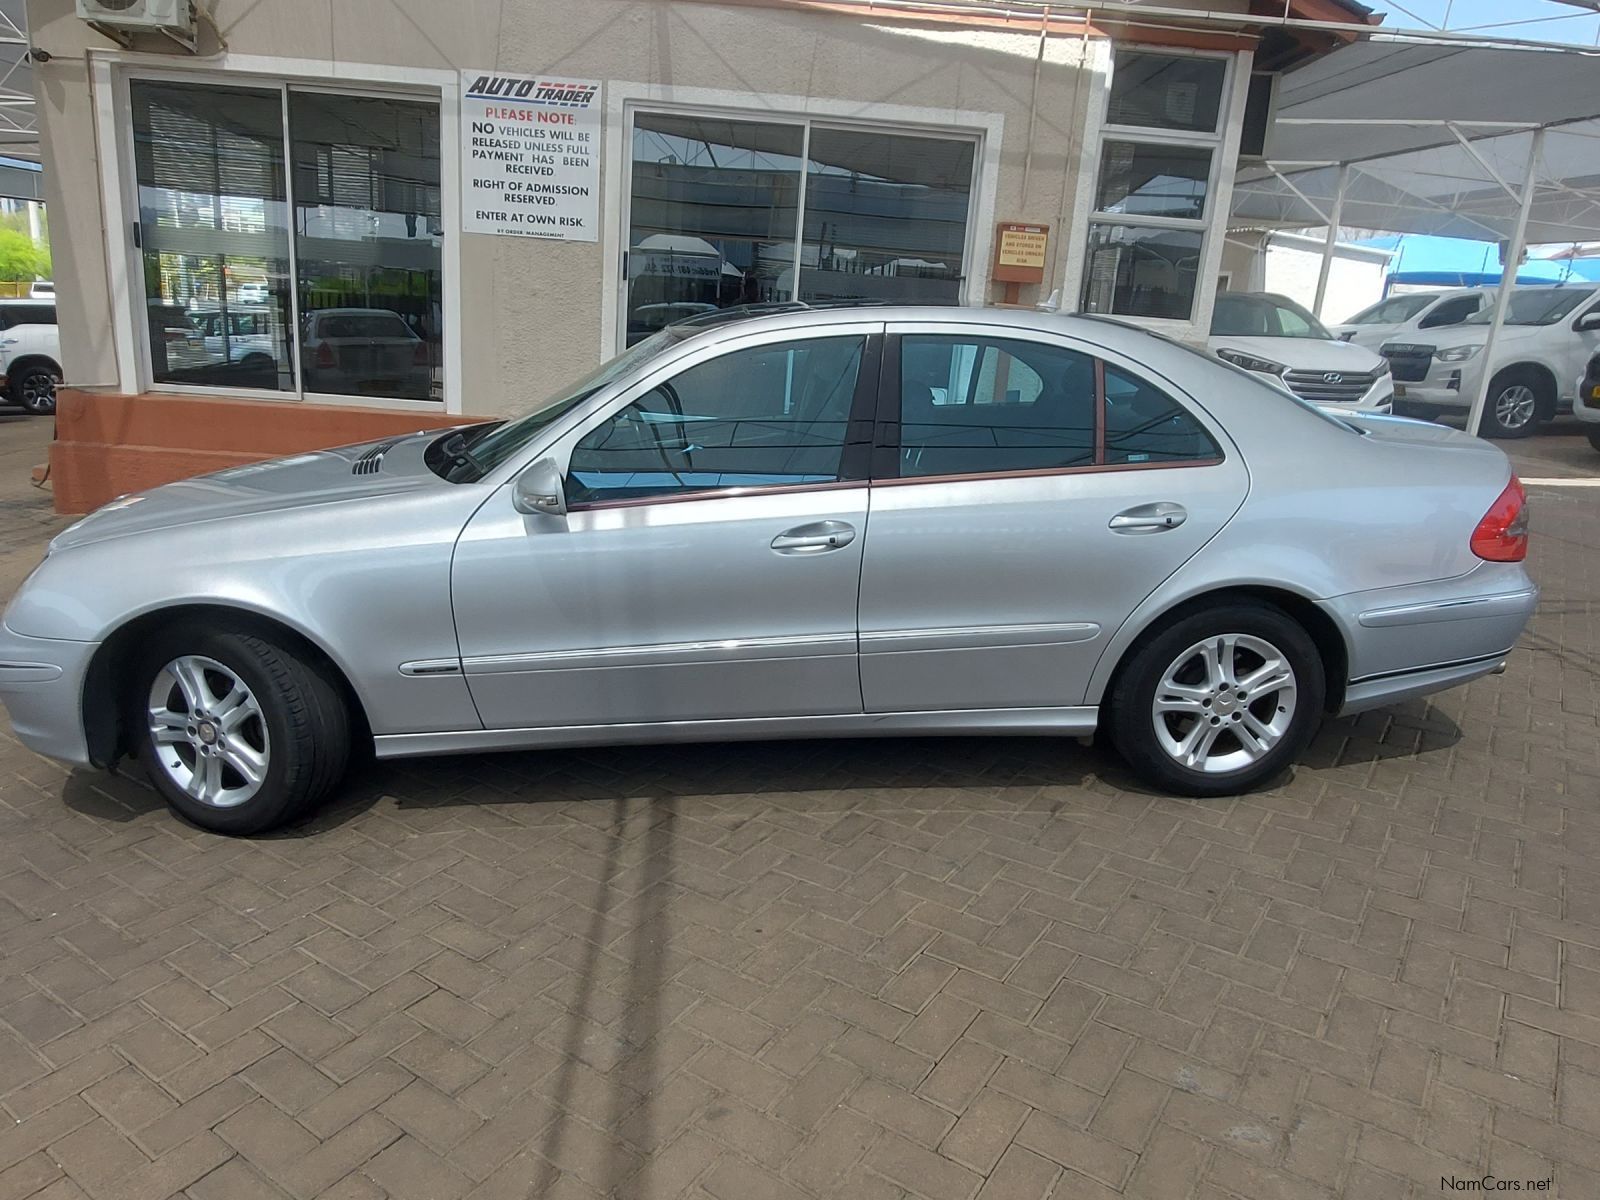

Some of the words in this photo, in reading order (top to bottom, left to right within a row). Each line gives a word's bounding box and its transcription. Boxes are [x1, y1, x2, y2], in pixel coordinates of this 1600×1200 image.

[468, 76, 536, 98] AUTO
[534, 88, 594, 103] TRADER
[486, 107, 533, 122] PLEASE
[472, 122, 494, 134] NO
[499, 126, 546, 138] VEHICLES
[550, 130, 574, 141] WILL
[578, 132, 590, 142] BE
[472, 137, 520, 150] RELEASED
[524, 144, 563, 153] UNLESS
[567, 146, 590, 155] FULL
[472, 150, 524, 163] PAYMENT
[532, 154, 554, 164] HAS
[562, 158, 589, 167] BEEN
[473, 178, 506, 190] RIGHT
[508, 182, 522, 192] OF
[526, 183, 588, 196] ADMISSION
[476, 210, 507, 222] ENTER
[510, 213, 524, 222] AT
[526, 214, 556, 225] OWN
